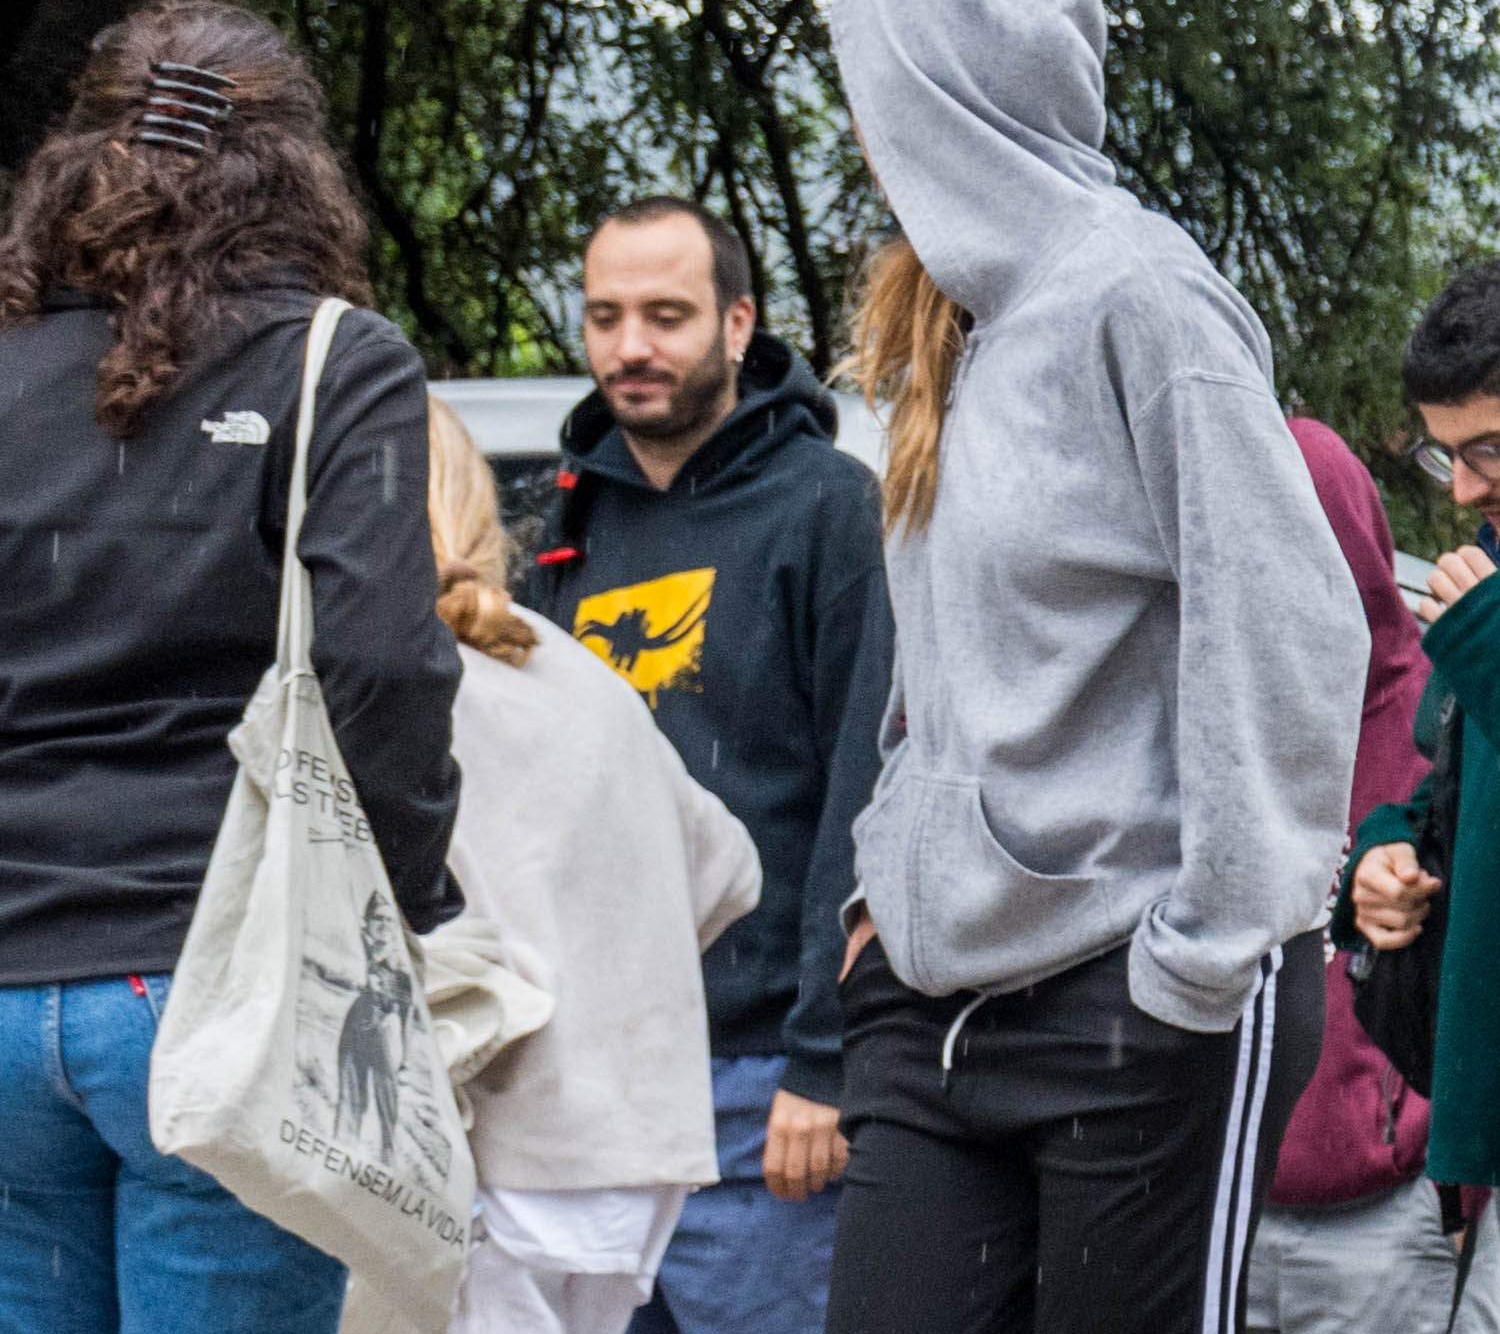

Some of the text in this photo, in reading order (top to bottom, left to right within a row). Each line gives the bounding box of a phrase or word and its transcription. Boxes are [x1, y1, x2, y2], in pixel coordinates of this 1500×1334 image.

[279, 1118, 466, 1252] DEFENSEM LA VIDA
